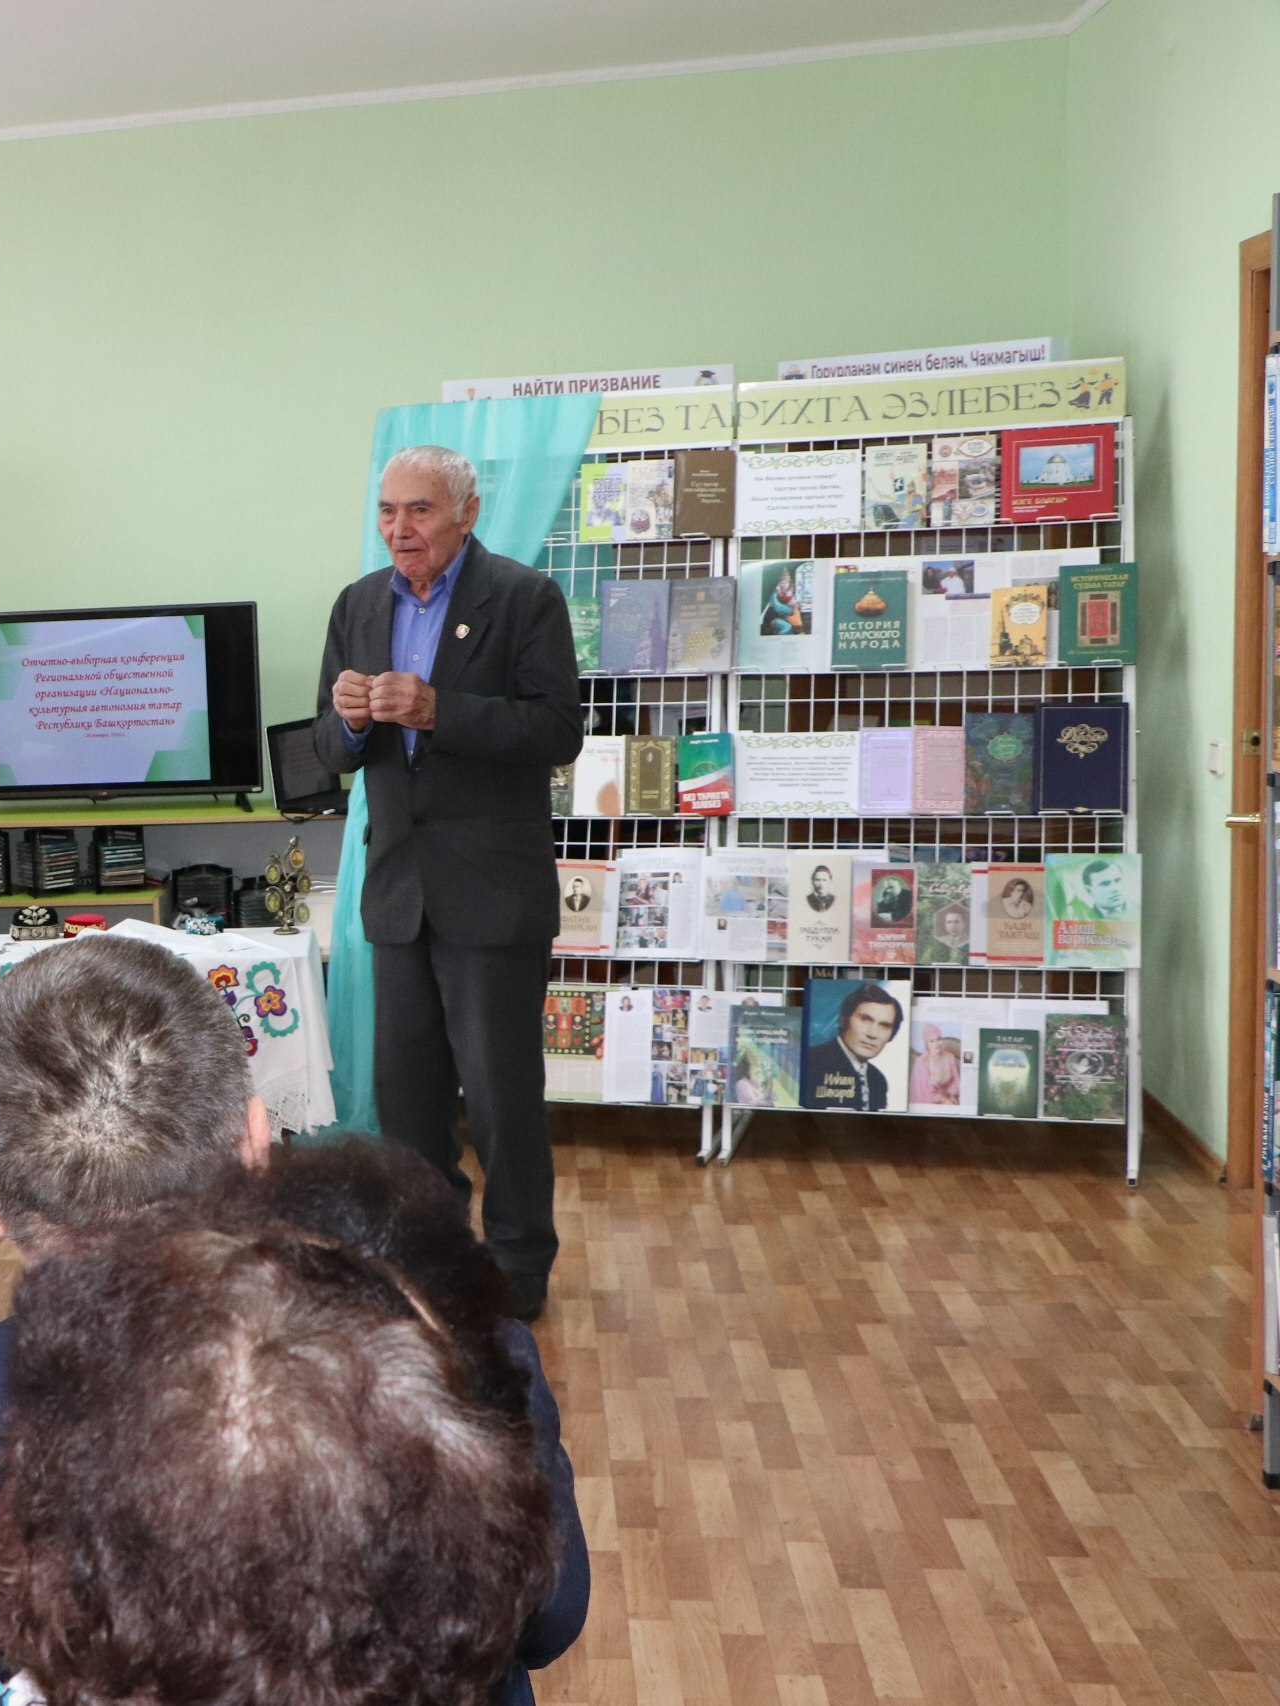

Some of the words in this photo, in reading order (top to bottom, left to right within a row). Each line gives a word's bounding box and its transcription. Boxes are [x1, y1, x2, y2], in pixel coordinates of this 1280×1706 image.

[970, 344, 1046, 366] Чакмагыш!
[513, 377, 564, 396] НАЙТИ
[568, 374, 661, 394] ПРИЗВАНИЕ
[597, 407, 665, 436] БЕЗ
[675, 394, 872, 432] ТАРИХТА
[881, 380, 1062, 420] ЭЗЛЕБЕЗ
[838, 620, 901, 631] ИСТОРИЯ
[838, 640, 901, 650] НАРОДА
[120, 651, 185, 667] конференция
[33, 670, 101, 683] Региональной
[103, 668, 174, 681] общественной
[35, 687, 96, 700] организации
[28, 703, 87, 716] культурная
[89, 702, 146, 713] автономия
[148, 700, 182, 714] татар
[36, 718, 93, 732] Республики
[95, 716, 176, 731] Башкортостан»
